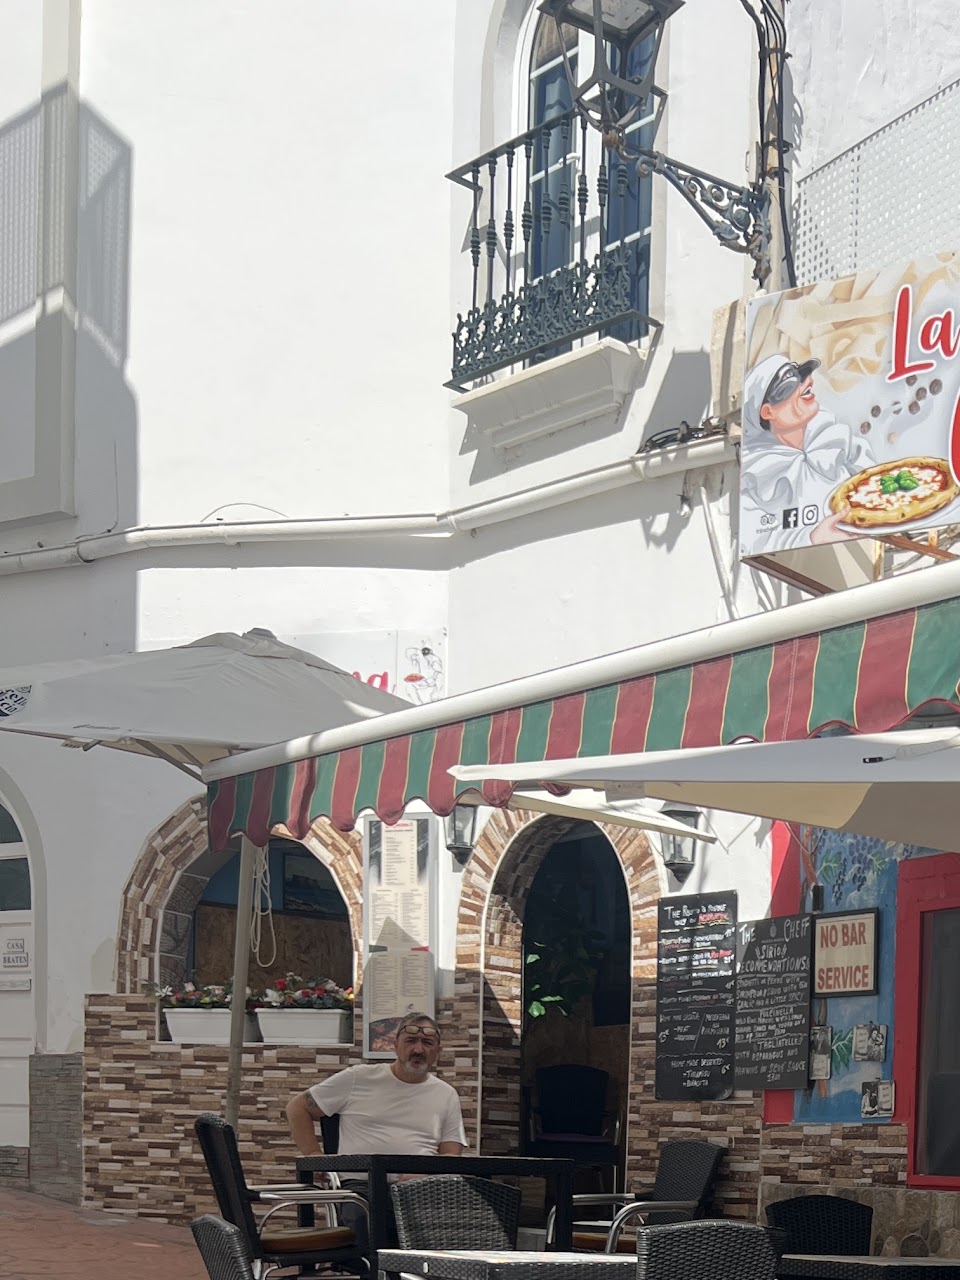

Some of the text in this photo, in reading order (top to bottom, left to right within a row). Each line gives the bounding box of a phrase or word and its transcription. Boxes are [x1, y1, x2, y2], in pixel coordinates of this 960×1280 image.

[739, 923, 757, 945] THE
[784, 917, 810, 942] CHEFF
[820, 922, 866, 948] NO BAR
[6, 942, 23, 950] CASA
[817, 965, 869, 990] SERVICE
[752, 1050, 784, 1061] ASPARAGUS
